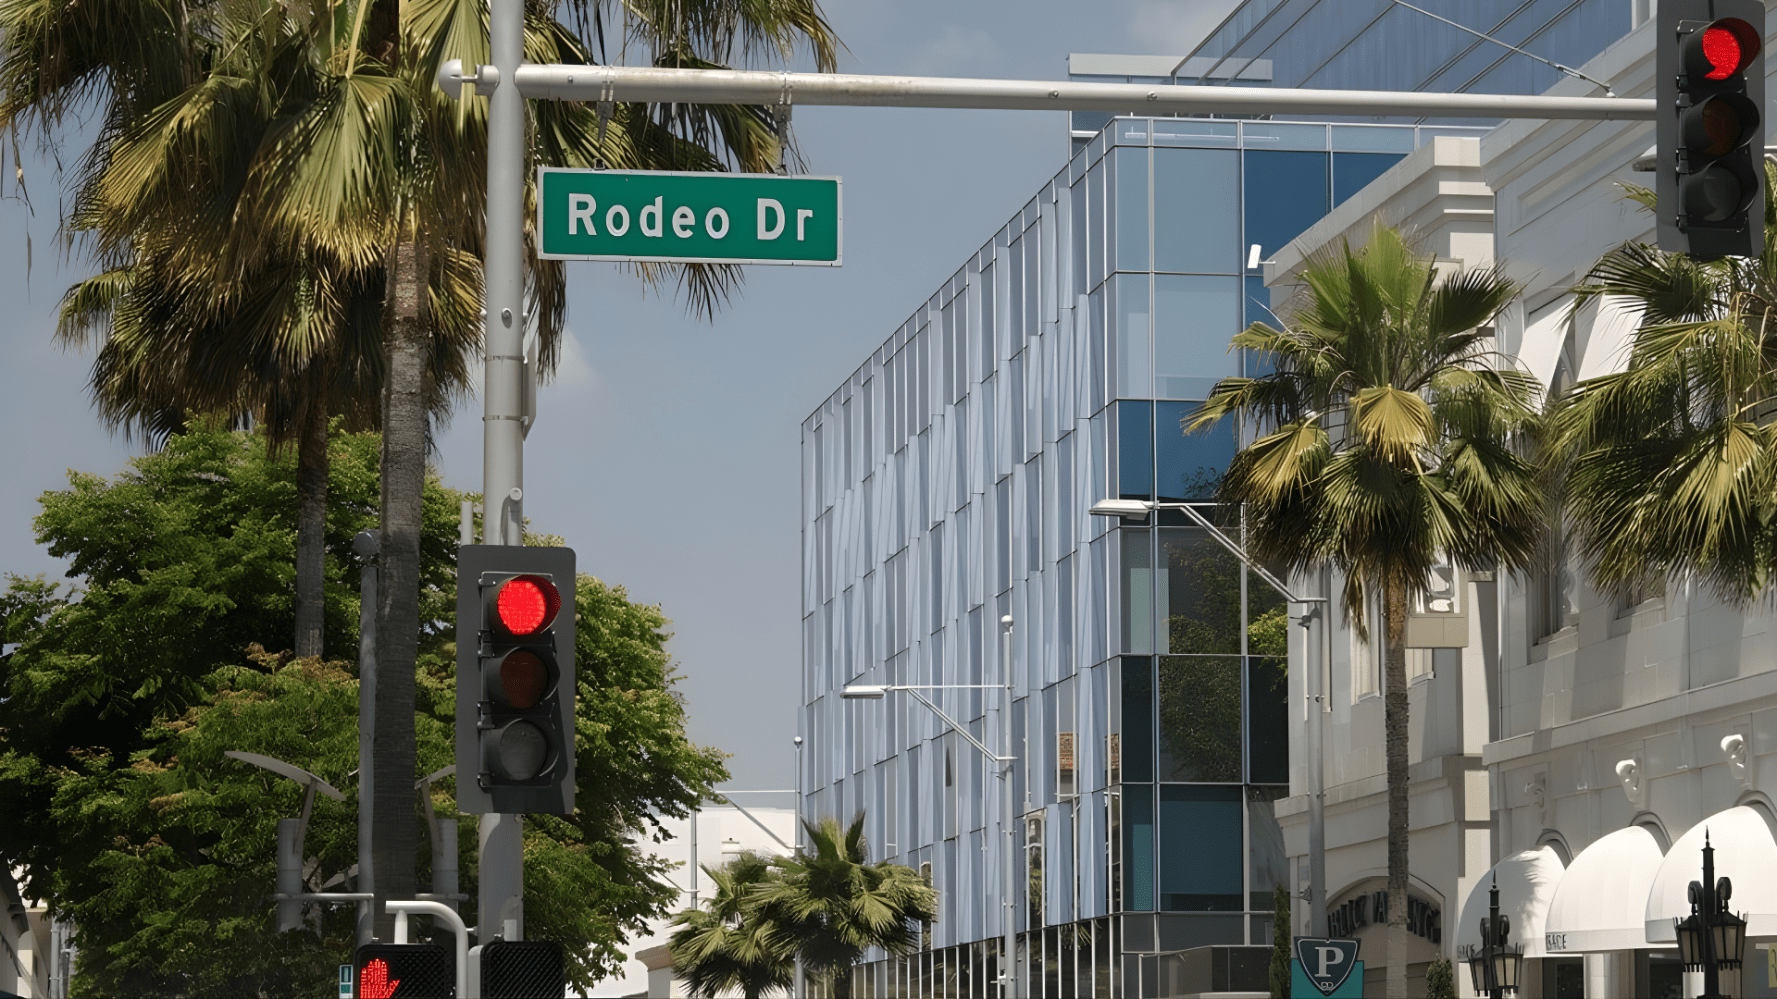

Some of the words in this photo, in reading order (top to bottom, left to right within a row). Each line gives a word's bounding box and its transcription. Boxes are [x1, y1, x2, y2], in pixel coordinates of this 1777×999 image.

[568, 193, 730, 240] Rodeo
[757, 197, 814, 241] Dr
[1314, 946, 1344, 977] P
